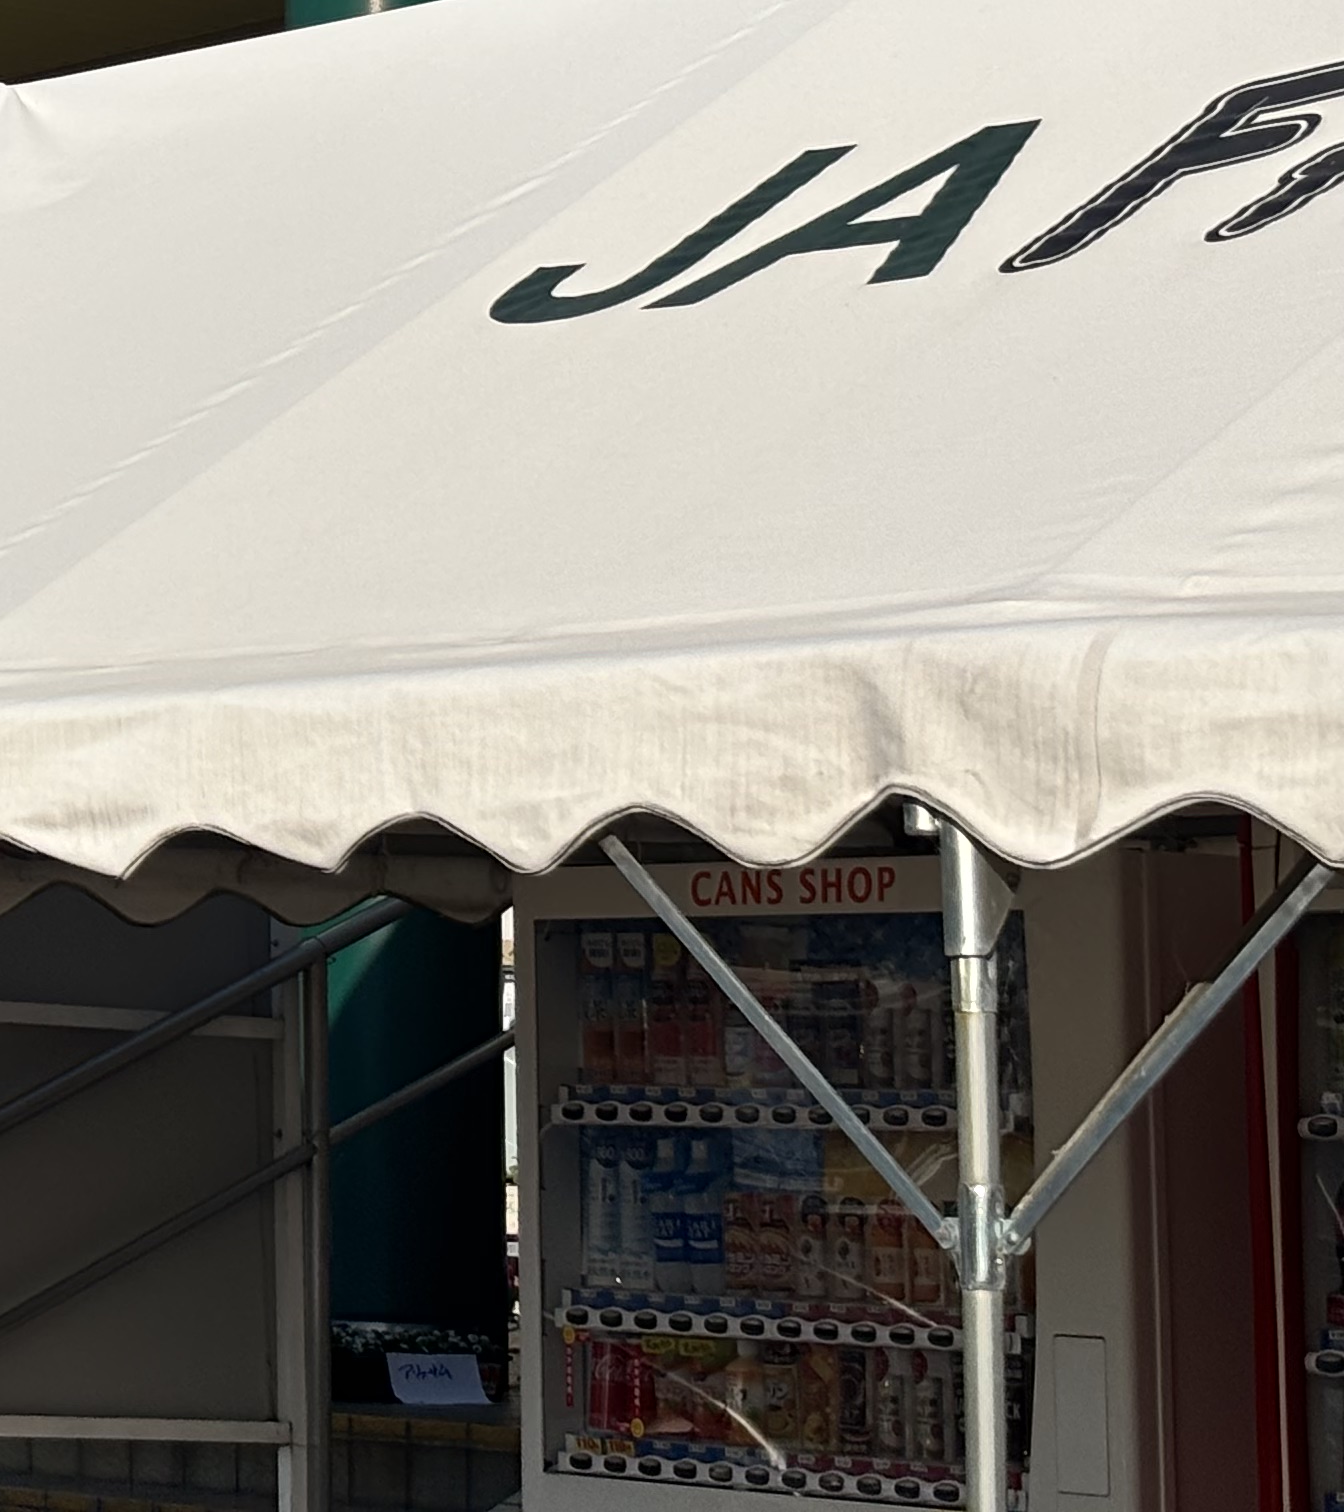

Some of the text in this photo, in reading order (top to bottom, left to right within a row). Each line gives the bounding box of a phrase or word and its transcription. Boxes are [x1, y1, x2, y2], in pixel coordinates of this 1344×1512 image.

[488, 59, 1344, 325] JA F
[691, 865, 897, 907] CANS SHOP
